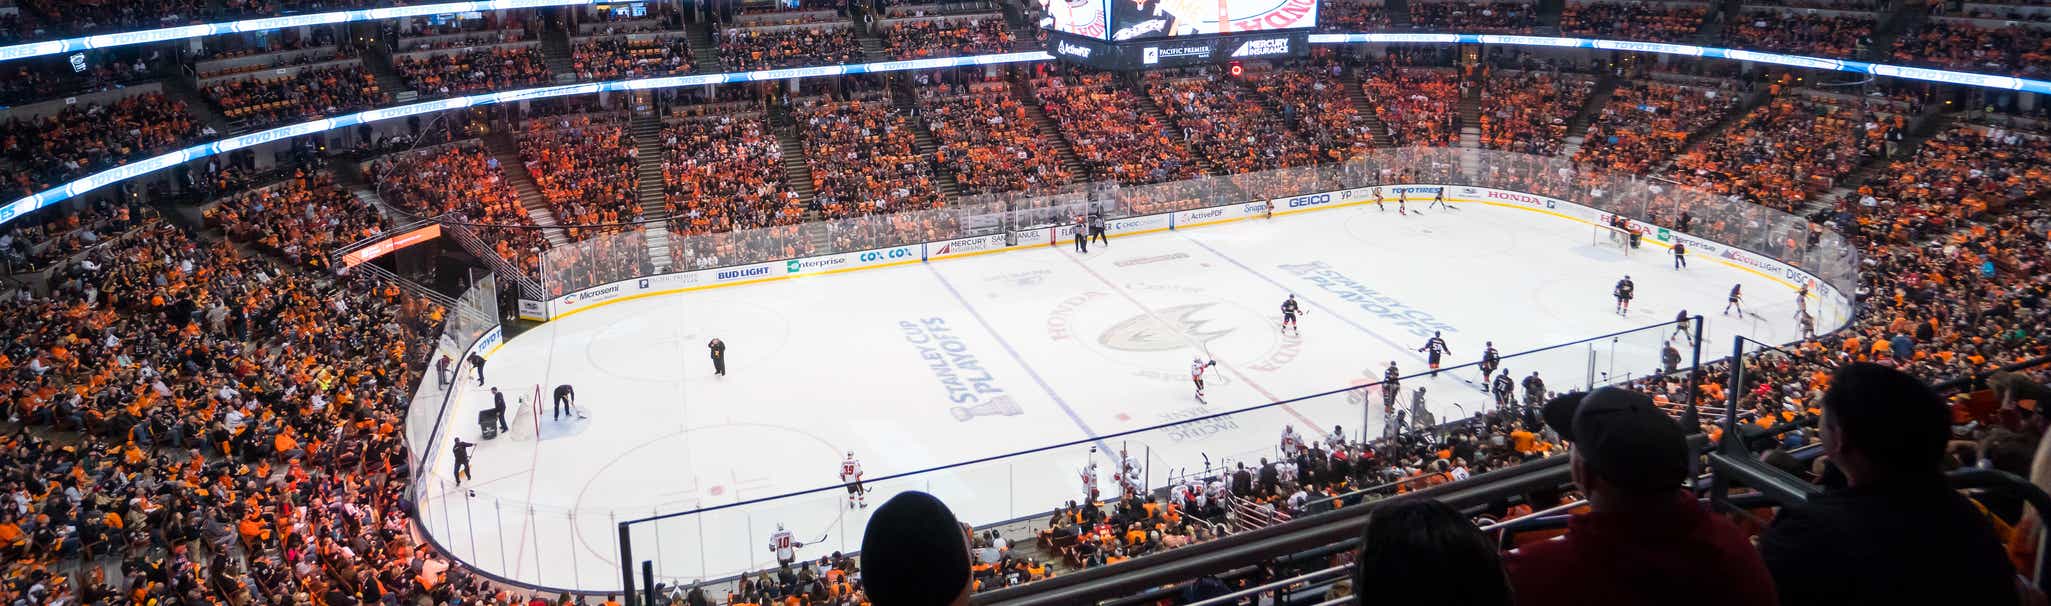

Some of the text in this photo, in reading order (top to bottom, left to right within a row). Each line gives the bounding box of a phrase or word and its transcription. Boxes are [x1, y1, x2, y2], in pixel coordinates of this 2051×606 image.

[1064, 43, 1091, 57] ActivePDF
[1249, 39, 1288, 48] MERCURY
[1160, 46, 1208, 56] PACIFIC PREMIER
[1249, 46, 1288, 56] INSURANCE
[240, 124, 309, 146] TOYO TIRES
[1290, 194, 1330, 207] GEICO
[1488, 191, 1541, 205] HONDA
[1191, 209, 1224, 219] ActivePDF
[1017, 230, 1040, 240] ANUEL
[951, 238, 987, 248] MERCURY
[787, 257, 845, 273] enterprise
[718, 266, 769, 280] BUD LIGHT
[579, 285, 619, 301] Microsemi
[899, 320, 979, 403] STANLEY CUP
[920, 317, 1005, 394] PLAYOFFS
[778, 536, 790, 549] 10
